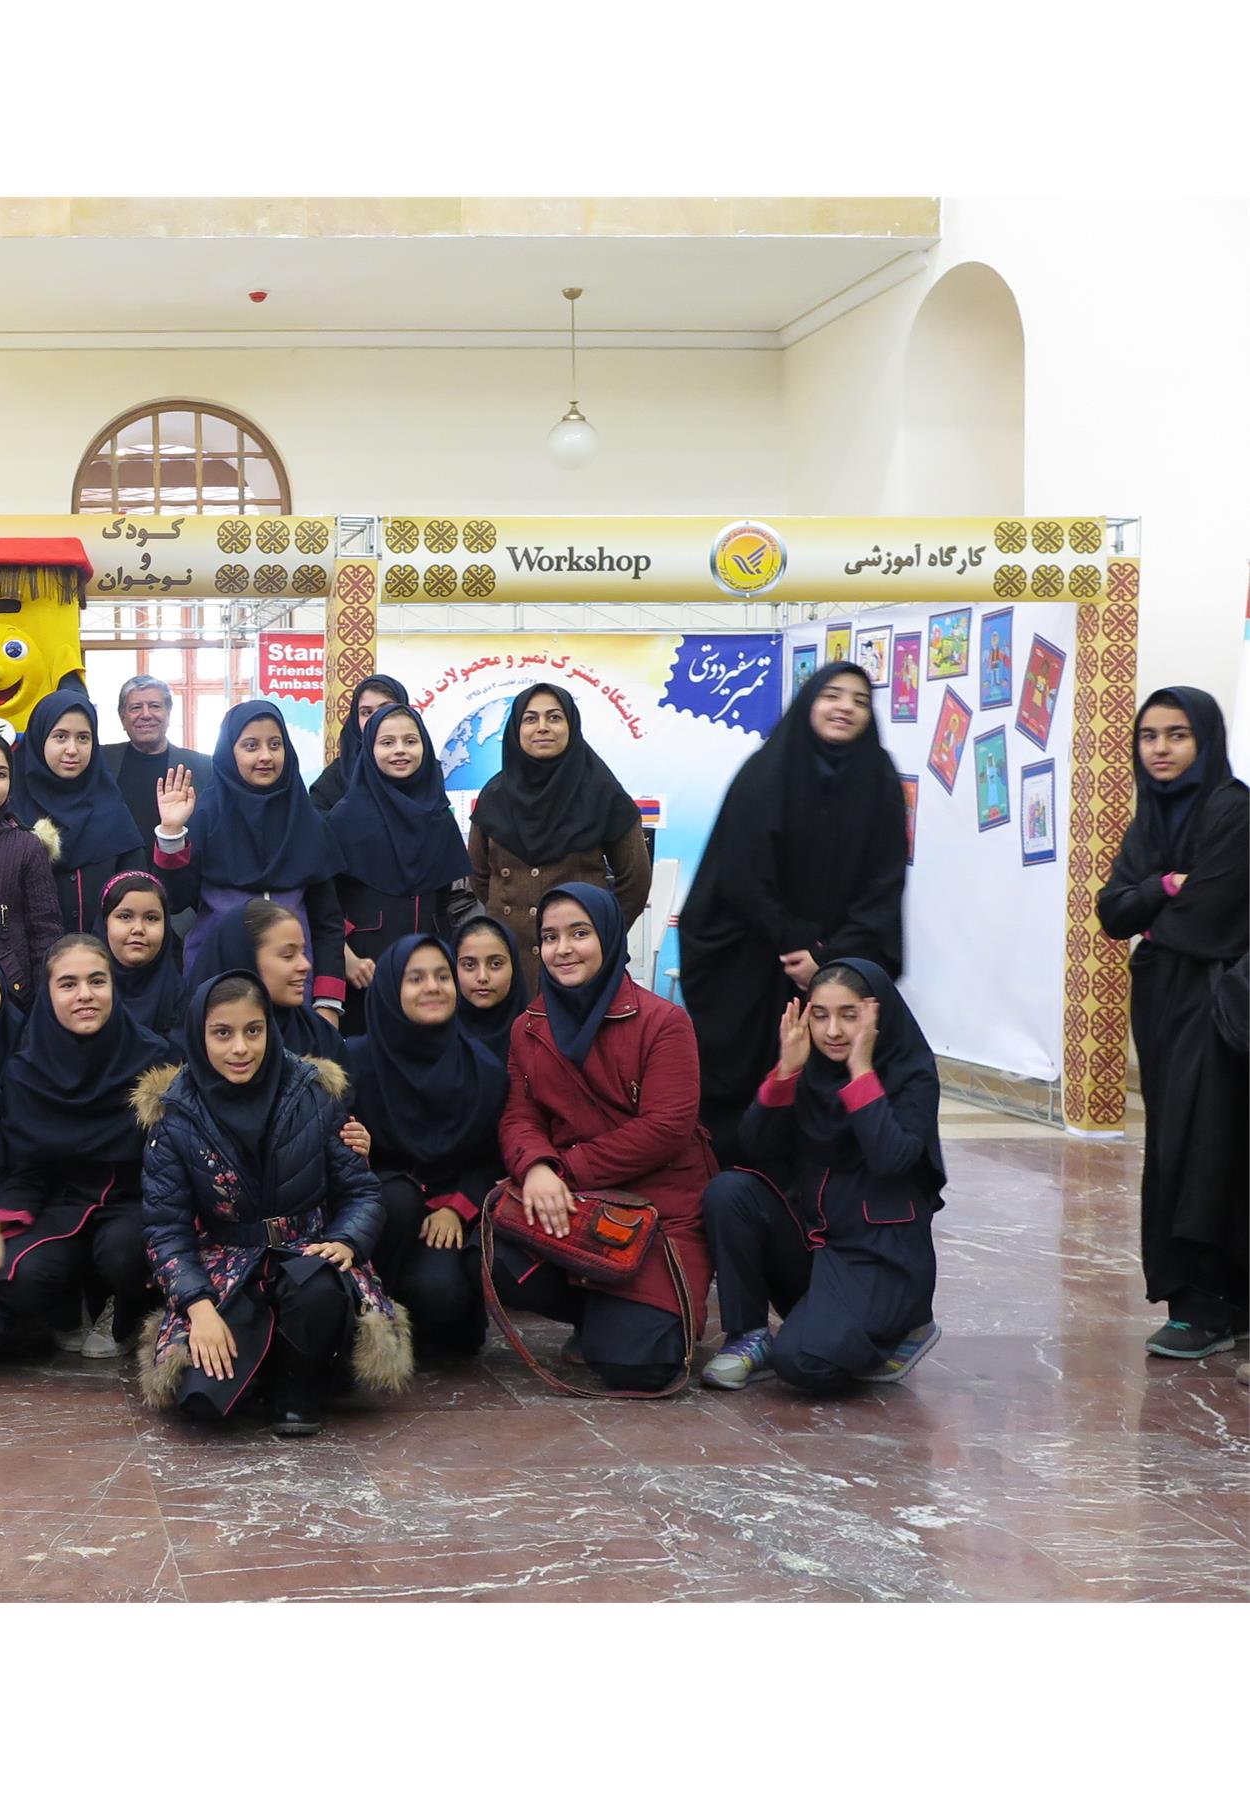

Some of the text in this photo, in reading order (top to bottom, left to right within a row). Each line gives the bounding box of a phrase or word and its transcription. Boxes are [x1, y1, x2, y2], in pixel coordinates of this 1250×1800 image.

[102, 517, 186, 548] کودک
[139, 552, 152, 571] و
[505, 546, 652, 580] Workshop
[844, 543, 987, 575] کارگاه آموزشی
[97, 566, 193, 592] نوجوان
[268, 642, 325, 662] Stam
[505, 654, 514, 669] و
[517, 649, 549, 668] تمبر
[268, 664, 323, 677] Friends
[435, 655, 501, 693] محصولات
[551, 655, 601, 688] مشترک
[268, 678, 326, 690] Ambass
[601, 685, 649, 740] نمایشگاه
